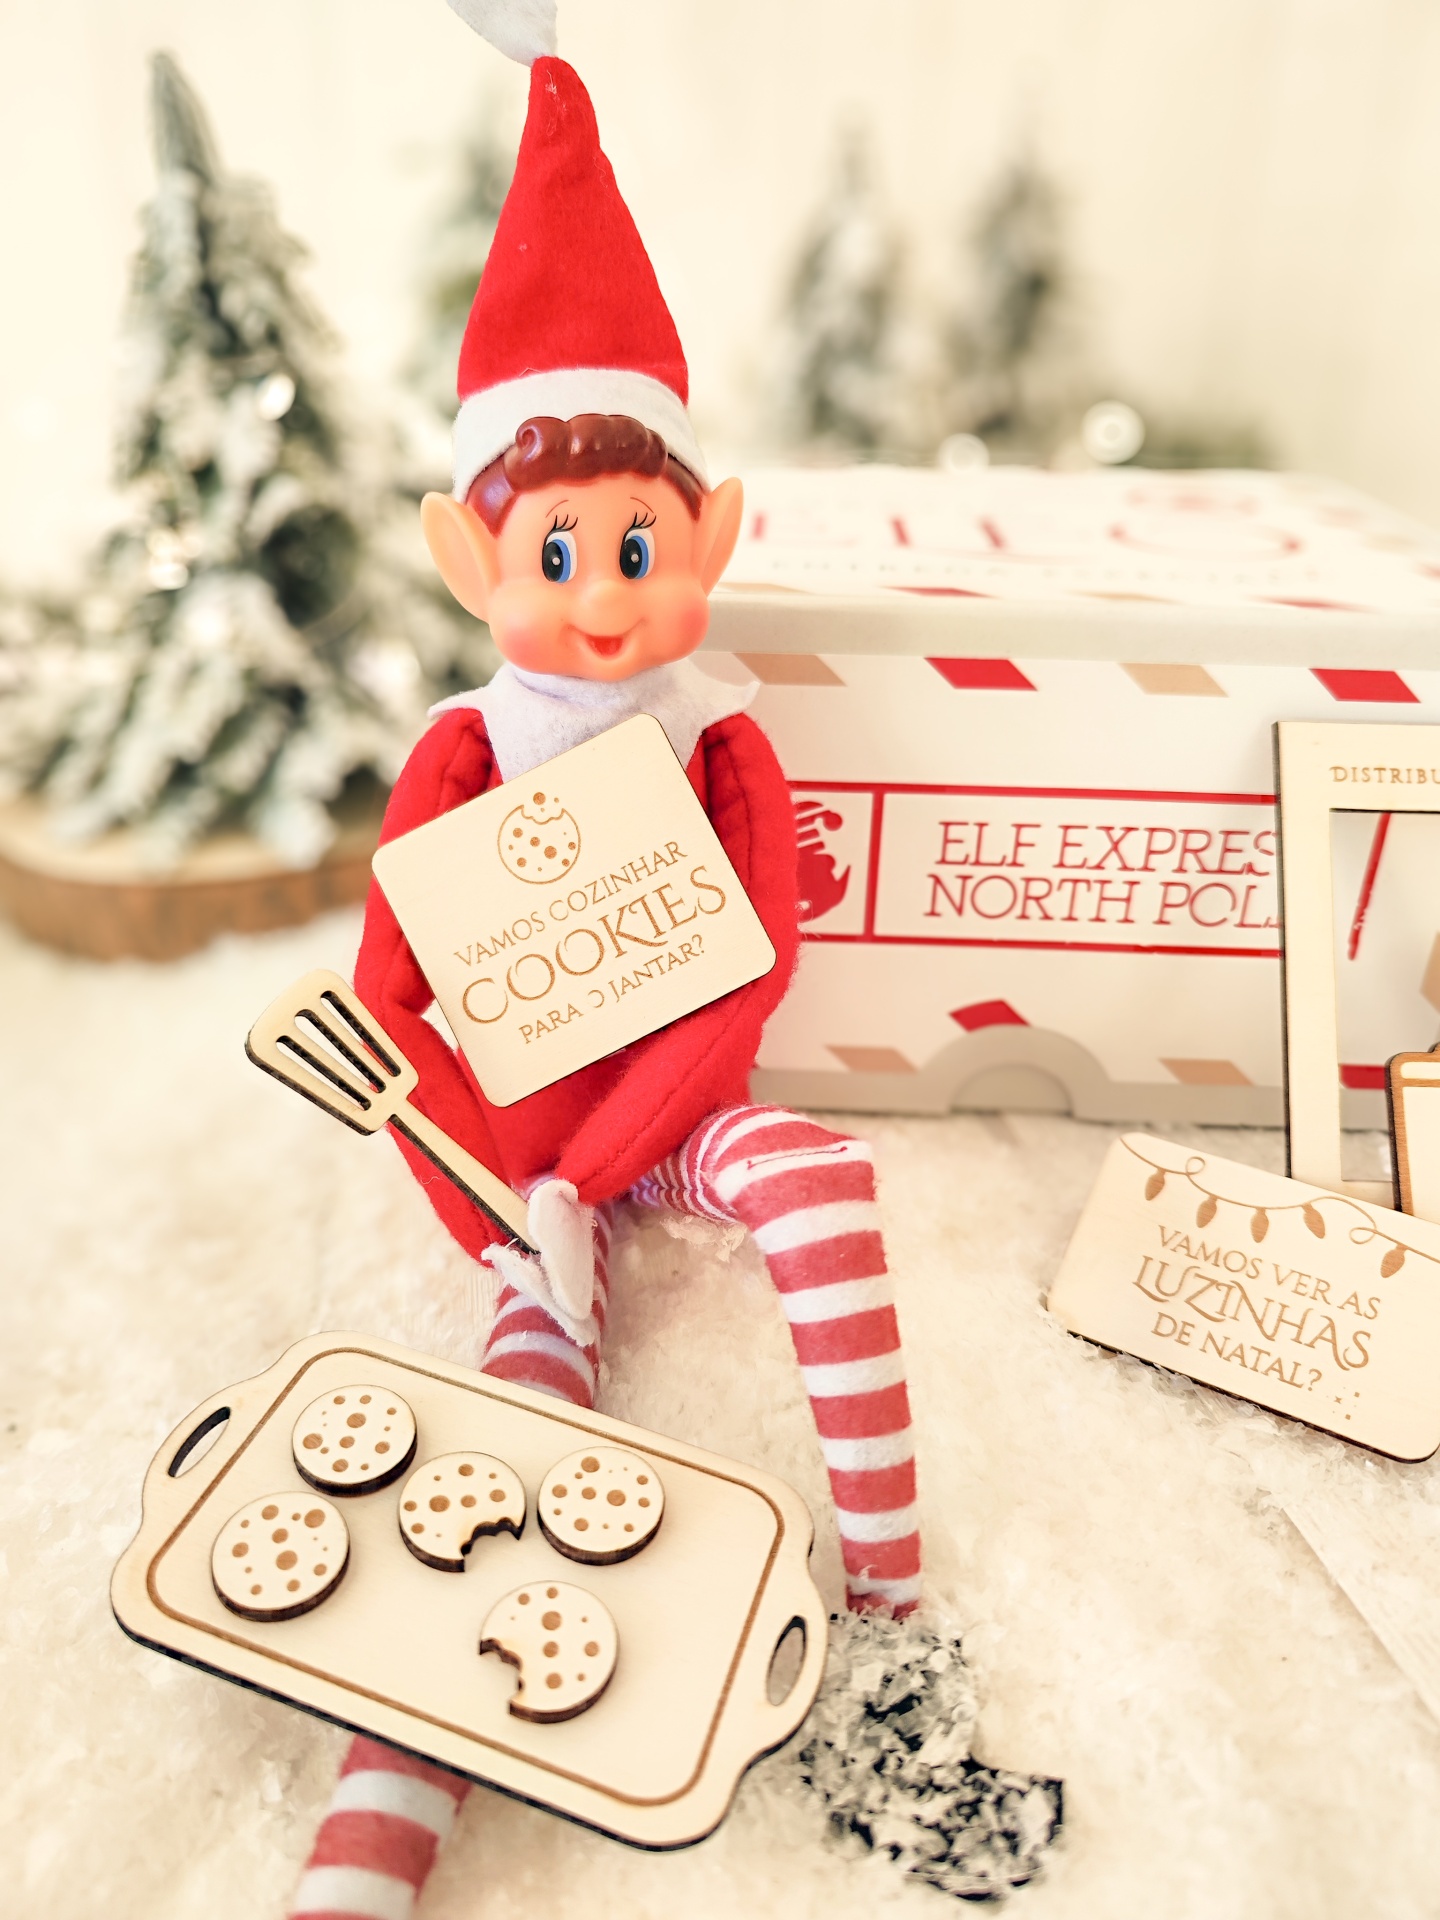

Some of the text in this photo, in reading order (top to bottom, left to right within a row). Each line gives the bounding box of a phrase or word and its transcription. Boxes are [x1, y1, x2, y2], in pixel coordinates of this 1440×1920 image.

[936, 821, 1042, 868] ELF
[454, 841, 688, 966] VAMOS COZINHAR
[462, 865, 727, 1024] COOKIES
[924, 874, 1281, 930] NORTH POL
[519, 1003, 584, 1044] PARA
[609, 934, 705, 1003] JANTAR?
[1132, 1256, 1371, 1371] LUZINHAS
[1159, 1226, 1382, 1321] VAMOS VER AS
[1151, 1312, 1323, 1392] DE NATAL?
